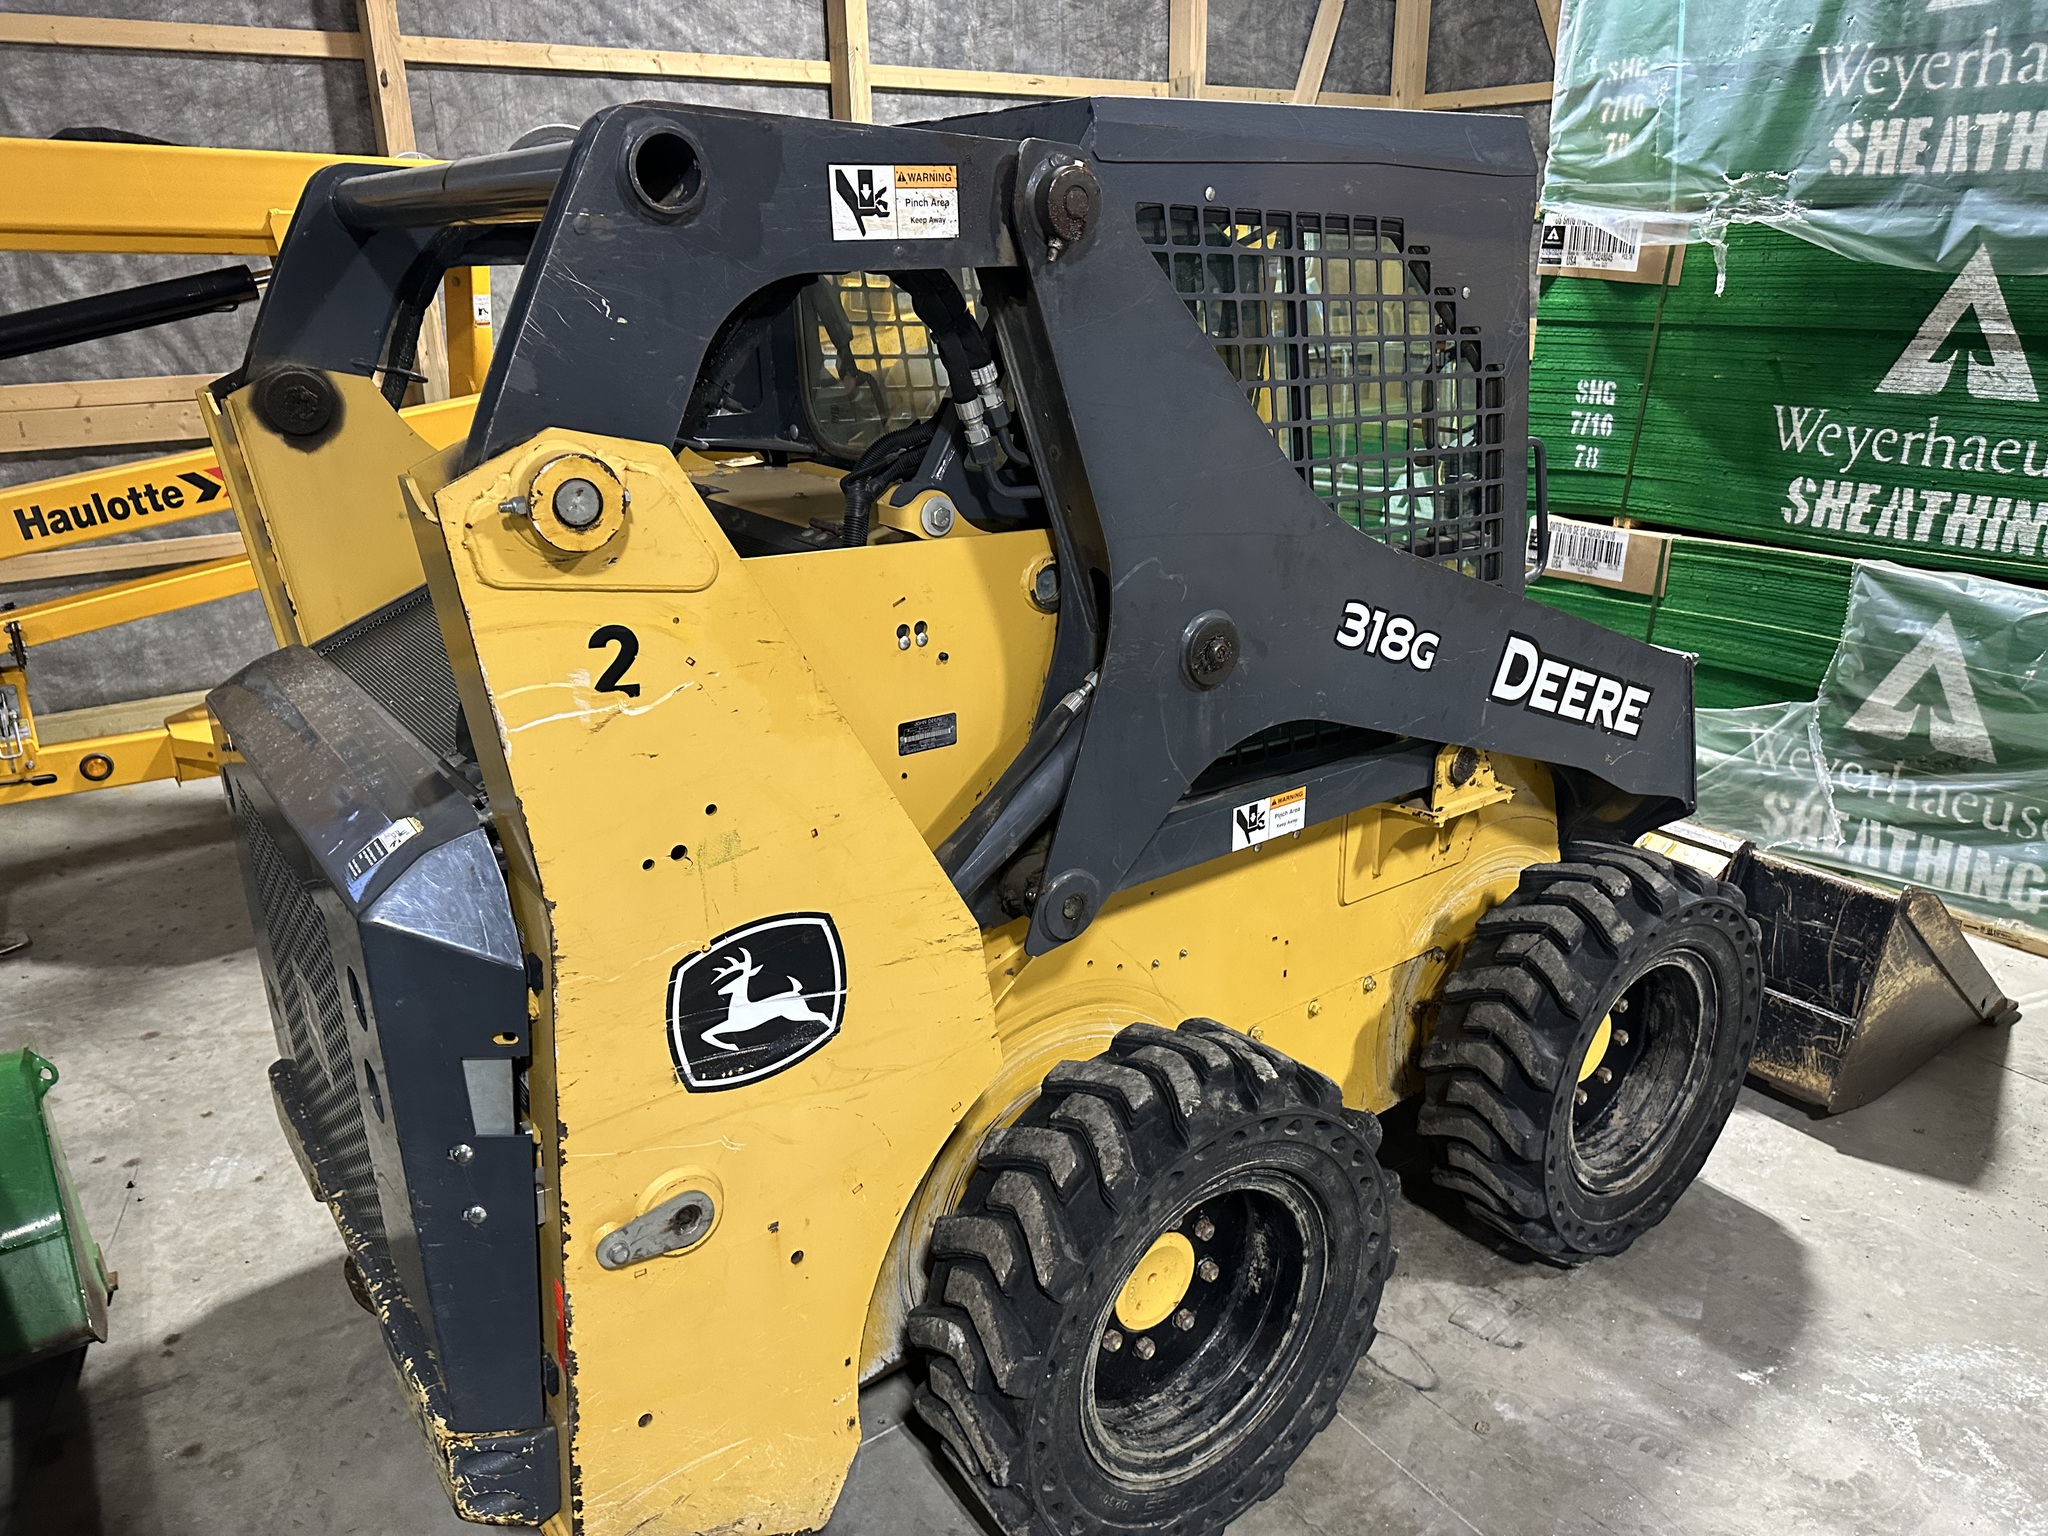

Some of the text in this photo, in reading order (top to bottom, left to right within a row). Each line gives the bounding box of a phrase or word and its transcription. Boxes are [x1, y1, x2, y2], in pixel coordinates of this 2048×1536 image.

[1817, 26, 2048, 110] Weyerha
[1828, 110, 2048, 176] SHEATH
[907, 172, 952, 182] WARNING
[905, 198, 950, 208] Pinch Area
[910, 216, 947, 225] Keep Away
[1576, 379, 1617, 406] SHG
[1571, 411, 1614, 437] 7/16
[1773, 404, 2048, 477] Weyerhaeu
[1574, 444, 1600, 469] 78
[13, 483, 185, 541] Haulotte
[1780, 476, 2048, 558] SHEATHIN
[1335, 602, 1441, 671] 318G
[588, 624, 641, 698] 2
[1490, 635, 1651, 737] DEERE
[1274, 806, 1301, 820] Pinch Area
[1277, 790, 1304, 804] WARNING
